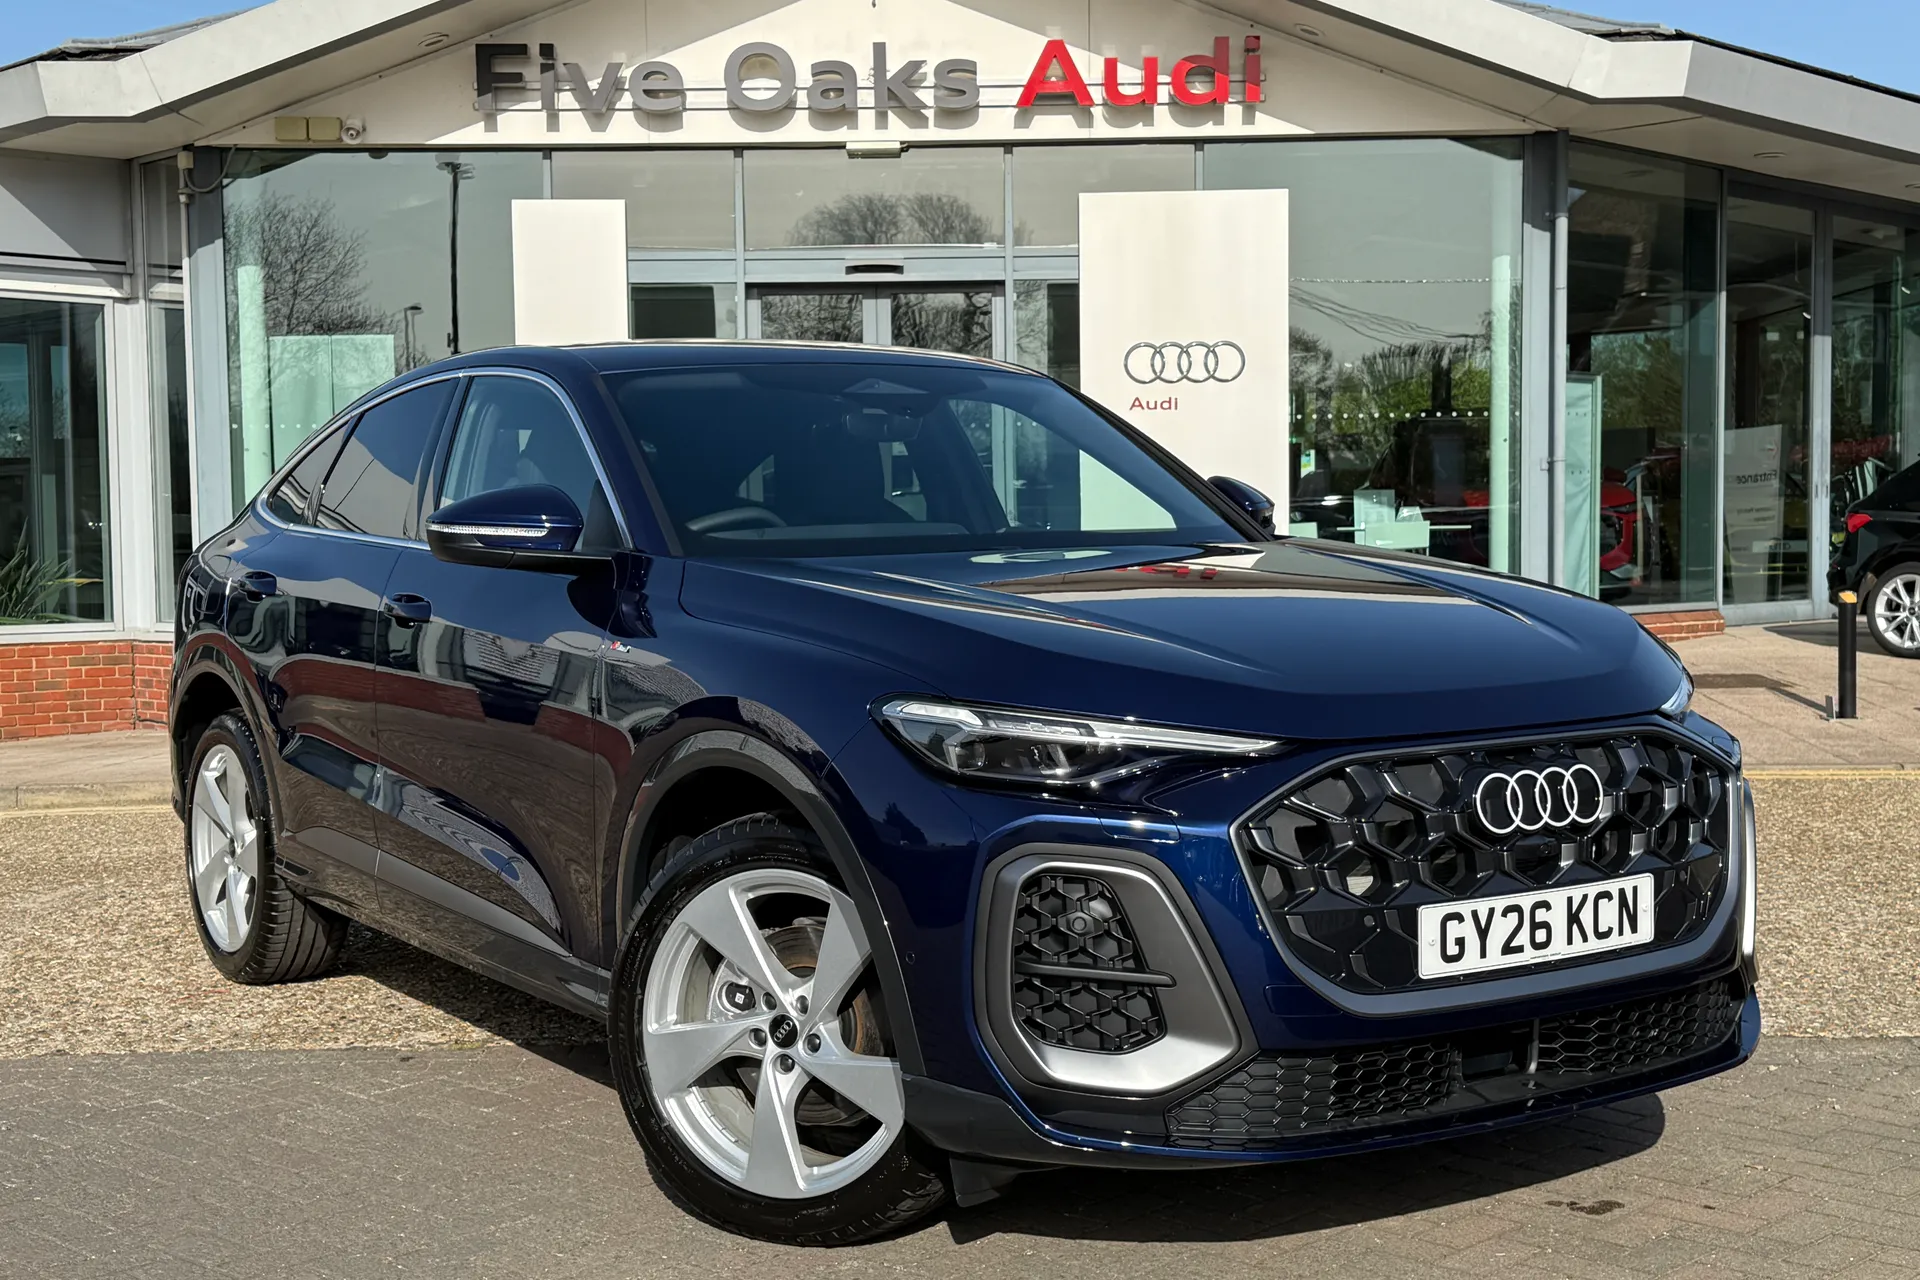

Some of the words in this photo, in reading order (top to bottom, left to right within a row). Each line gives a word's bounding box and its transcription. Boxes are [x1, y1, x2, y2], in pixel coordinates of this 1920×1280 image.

[475, 43, 685, 113] Five
[724, 42, 980, 111] Oaks
[1015, 35, 1261, 107] Audi
[1129, 397, 1178, 411] Audi
[1439, 899, 1553, 964] GY26
[1566, 884, 1639, 947] KCN
